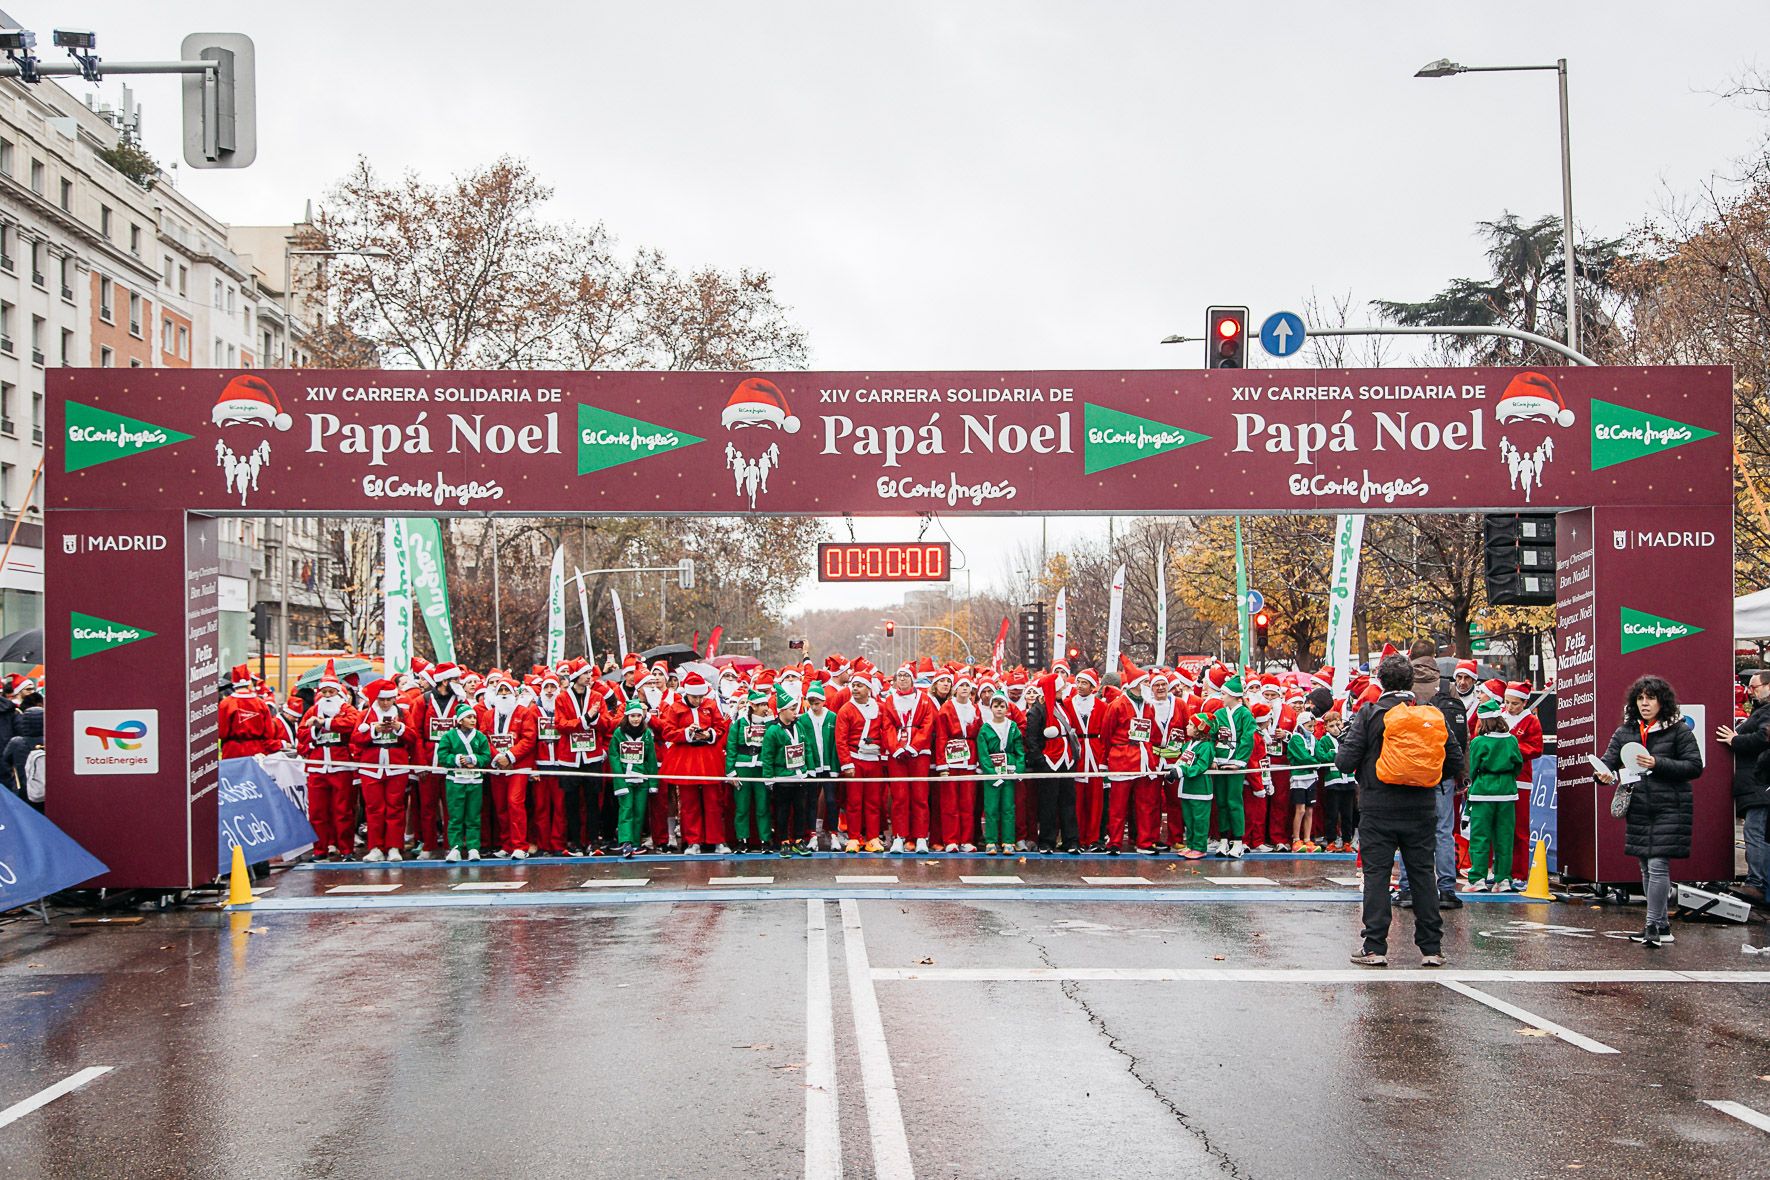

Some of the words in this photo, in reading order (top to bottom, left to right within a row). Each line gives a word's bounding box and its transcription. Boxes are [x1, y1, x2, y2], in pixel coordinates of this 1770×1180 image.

[306, 388, 338, 401] XIV
[343, 387, 430, 402] CARRERA
[434, 388, 533, 402] SOLIDARIA
[538, 389, 562, 402] DE
[819, 389, 851, 403] XIV
[855, 389, 942, 402] CARRERA
[946, 389, 1045, 402] SOLIDARIA
[1050, 389, 1074, 402] DE
[1231, 387, 1263, 400] XIV
[1267, 386, 1355, 400] CARRERA
[1359, 386, 1457, 399] SOLIDARIA
[1462, 386, 1486, 398] DE
[69, 426, 84, 442] El
[84, 427, 118, 443] Corte
[118, 424, 167, 448] Inglés
[305, 412, 434, 466] Papá
[446, 412, 562, 454] Noel
[582, 429, 597, 445] El
[597, 430, 630, 445] Corte
[630, 427, 679, 450] Inglés
[819, 412, 947, 468] Papá
[959, 412, 1074, 454] Noel
[1089, 428, 1103, 444] El
[1104, 429, 1137, 445] Corte
[1137, 426, 1185, 450] Inglés
[1231, 410, 1359, 465] Papá
[1371, 408, 1487, 451] Noel
[1595, 424, 1610, 440] El
[1610, 425, 1643, 440] Corte
[1644, 422, 1692, 445] Inglés
[363, 475, 384, 498] El
[385, 476, 433, 499] Corte
[434, 472, 504, 506] Inglés
[877, 475, 898, 498] El
[899, 476, 946, 499] Corte
[947, 472, 1017, 506] Inglés
[1289, 473, 1310, 496] El
[1311, 474, 1358, 497] Corte
[1359, 470, 1429, 504] Inglés
[88, 536, 167, 551] MADRID
[1638, 532, 1715, 547] MADRID
[827, 548, 941, 577] 00:00:00
[1560, 576, 1571, 589] Bon
[1572, 565, 1590, 583] Nadal
[1558, 612, 1579, 629] Joyeux
[1579, 604, 1593, 619] Noël
[1565, 632, 1586, 652] Feliz
[1558, 645, 1593, 670] Navidad
[1558, 676, 1573, 690] Buon
[1574, 669, 1593, 687] Natale
[1558, 697, 1573, 709] Boas
[1573, 692, 1594, 706] Festas
[85, 756, 148, 766] TotalEnergies
[1533, 773, 1547, 808] la
[234, 812, 275, 846] Cielo
